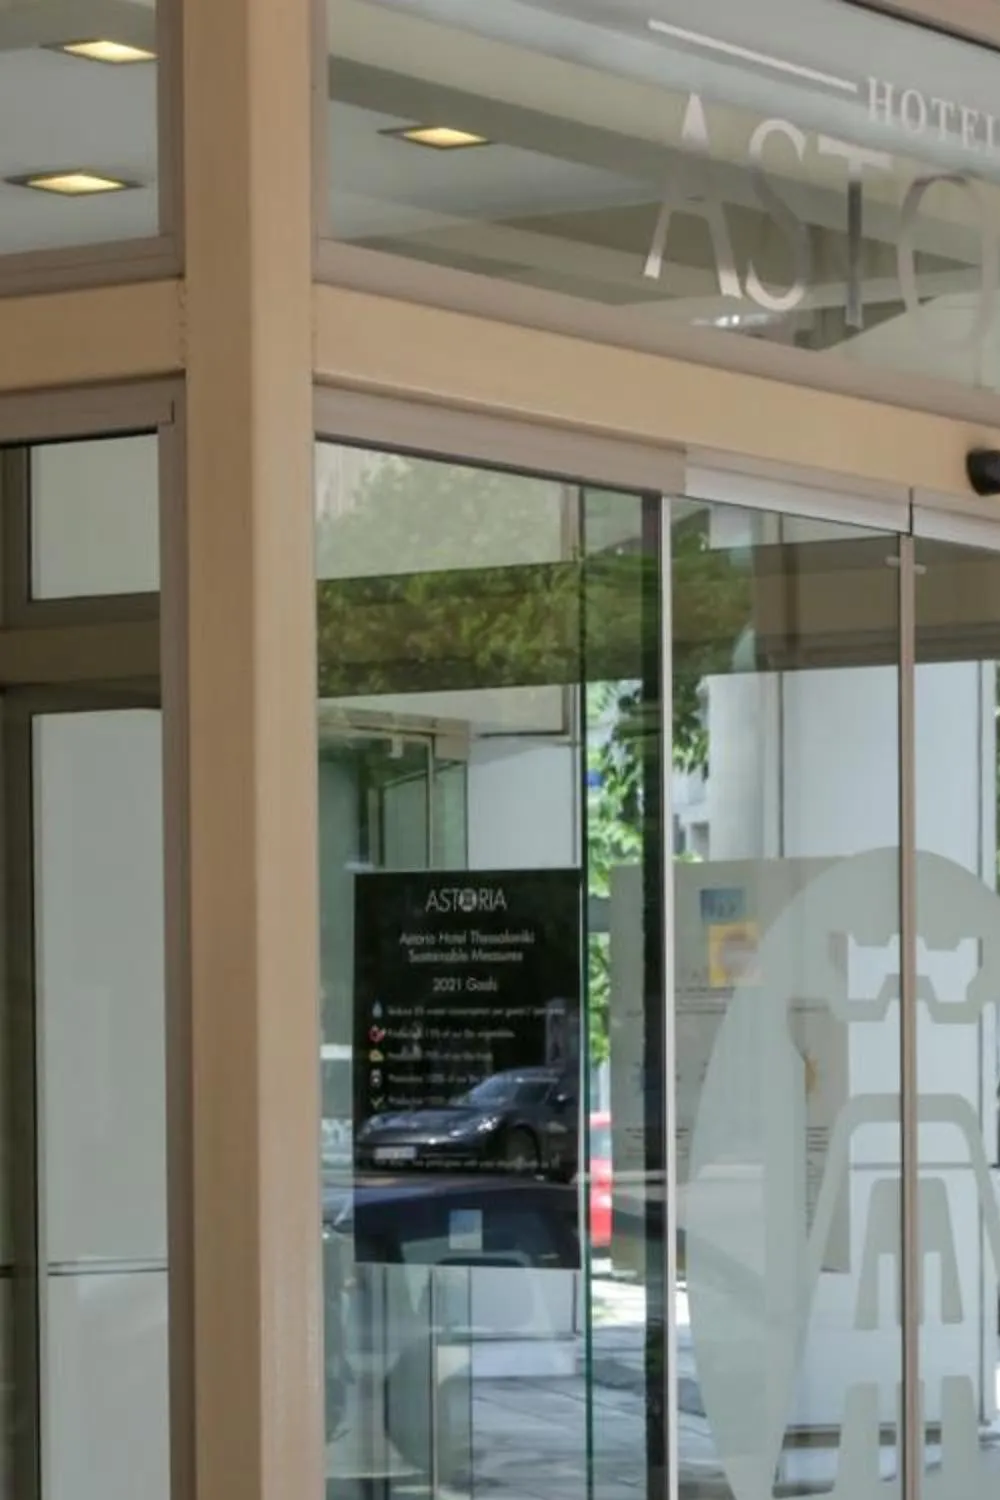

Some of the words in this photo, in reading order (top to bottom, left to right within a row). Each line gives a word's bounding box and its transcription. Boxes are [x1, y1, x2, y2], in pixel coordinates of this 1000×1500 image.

[867, 76, 998, 157] HOTEL
[425, 888, 508, 913] ASTORIA
[433, 977, 462, 991] 2021
